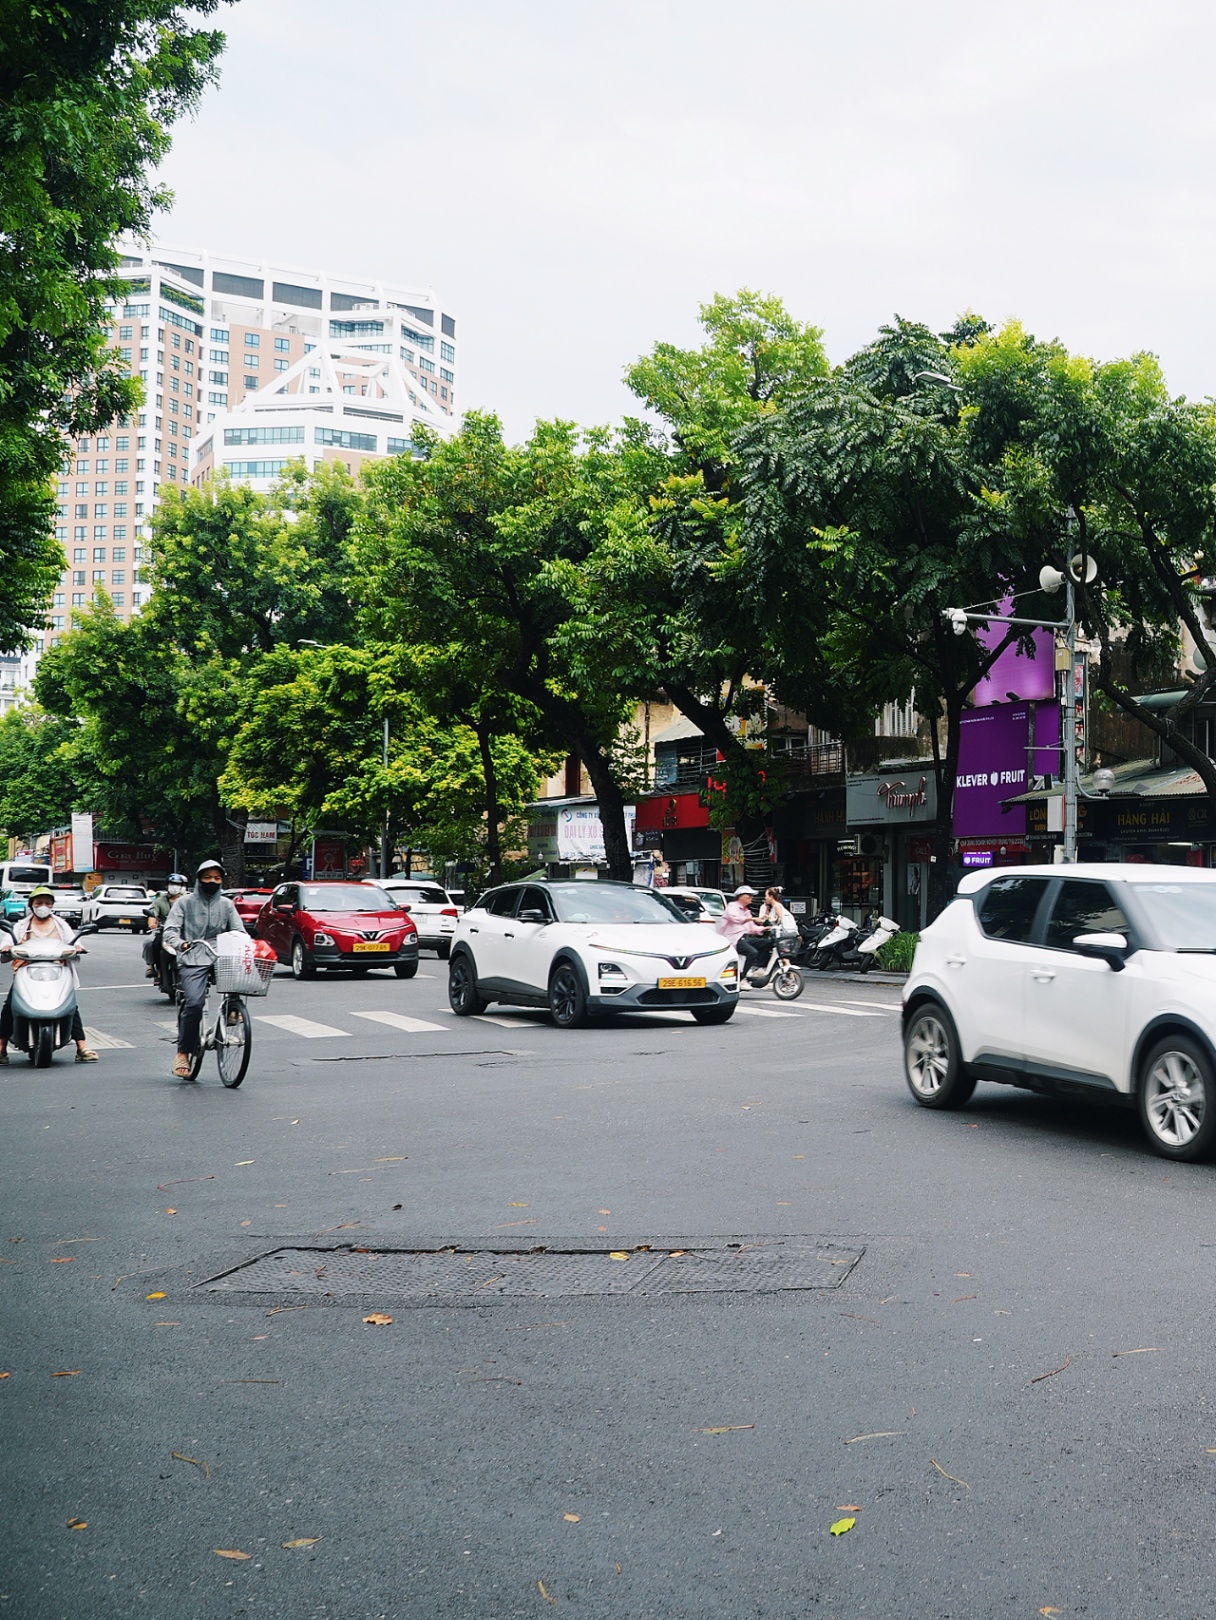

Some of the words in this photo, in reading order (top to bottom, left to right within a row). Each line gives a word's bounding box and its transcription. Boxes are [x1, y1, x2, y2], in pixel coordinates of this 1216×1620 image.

[956, 773, 988, 788] KLEVER
[1000, 769, 1026, 784] FRUIT
[877, 776, 927, 817] Triumph
